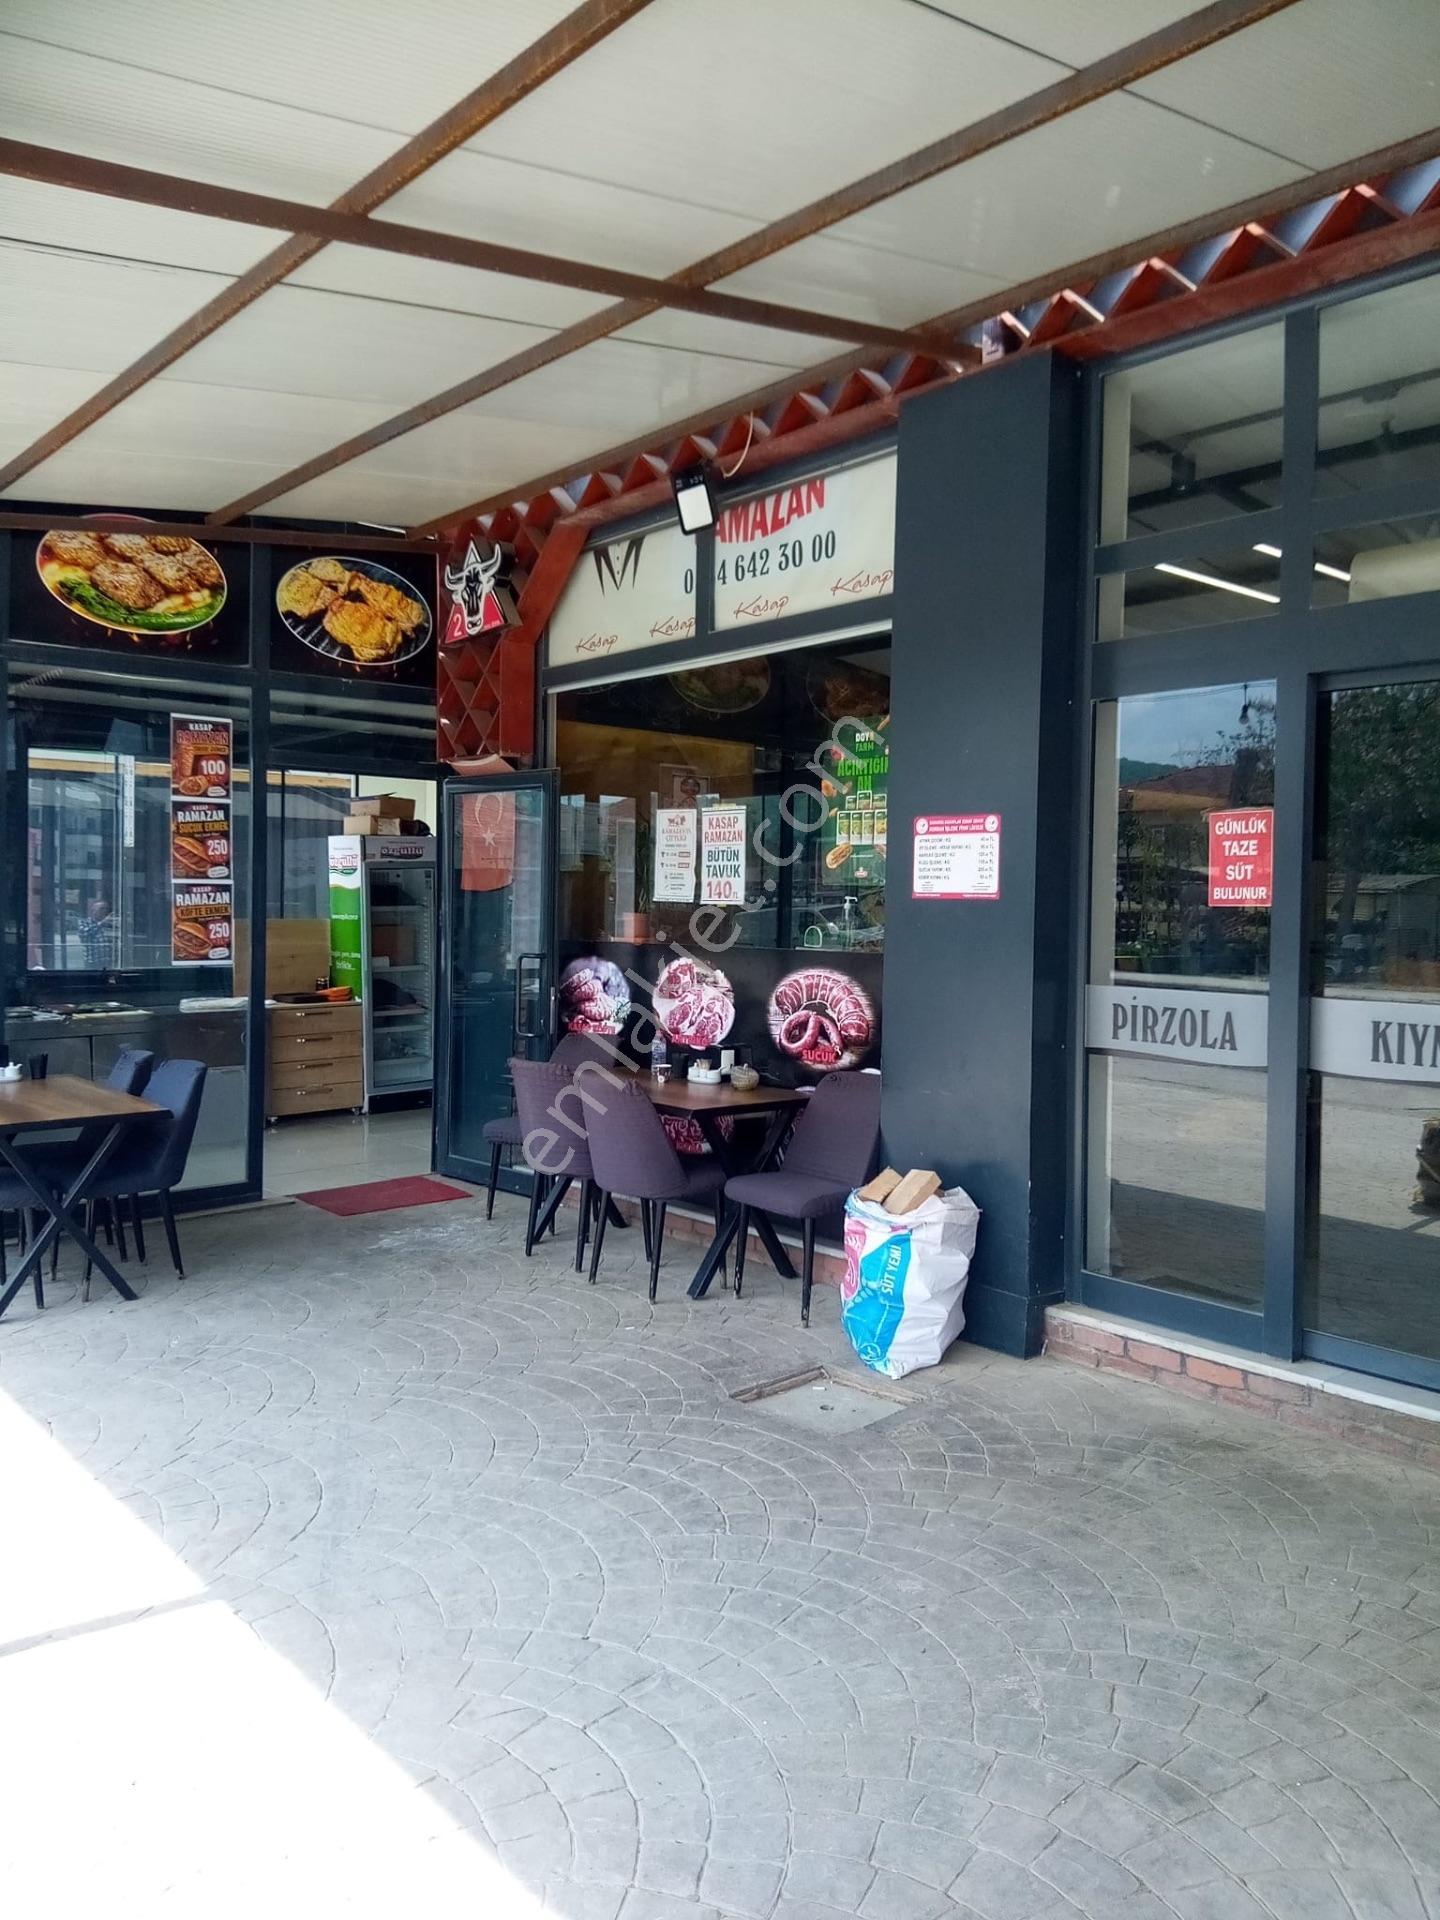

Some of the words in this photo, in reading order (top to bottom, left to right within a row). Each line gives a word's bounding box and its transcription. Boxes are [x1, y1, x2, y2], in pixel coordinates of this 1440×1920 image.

[715, 480, 825, 543] AMAZAN
[735, 548, 770, 582] 642
[778, 540, 803, 571] 30
[812, 530, 836, 562] 00
[830, 569, 893, 596] Kasap
[733, 595, 789, 619] Kasap
[453, 613, 462, 637] 2
[649, 616, 695, 638] Kasap
[576, 633, 618, 653] Kasap
[201, 760, 226, 775] 100
[177, 810, 225, 823] RAMAZAN
[708, 816, 739, 830] KASAP
[1215, 817, 1267, 836] GÜNLÜK
[704, 830, 743, 843] RAMAZAN
[207, 839, 228, 856] 250
[707, 847, 740, 862] BÜTÜN
[1222, 840, 1258, 856] TAZE
[705, 864, 741, 879] TAVUK
[1226, 861, 1254, 880] SÜT
[706, 881, 733, 899] 140
[1213, 887, 1267, 900] BULUNUR
[175, 891, 231, 907] RAMAZAN
[209, 922, 230, 939] 250
[1112, 996, 1238, 1051] PİRZOLA
[802, 1049, 836, 1063] SUCUK
[880, 1271, 896, 1296] SÜT
